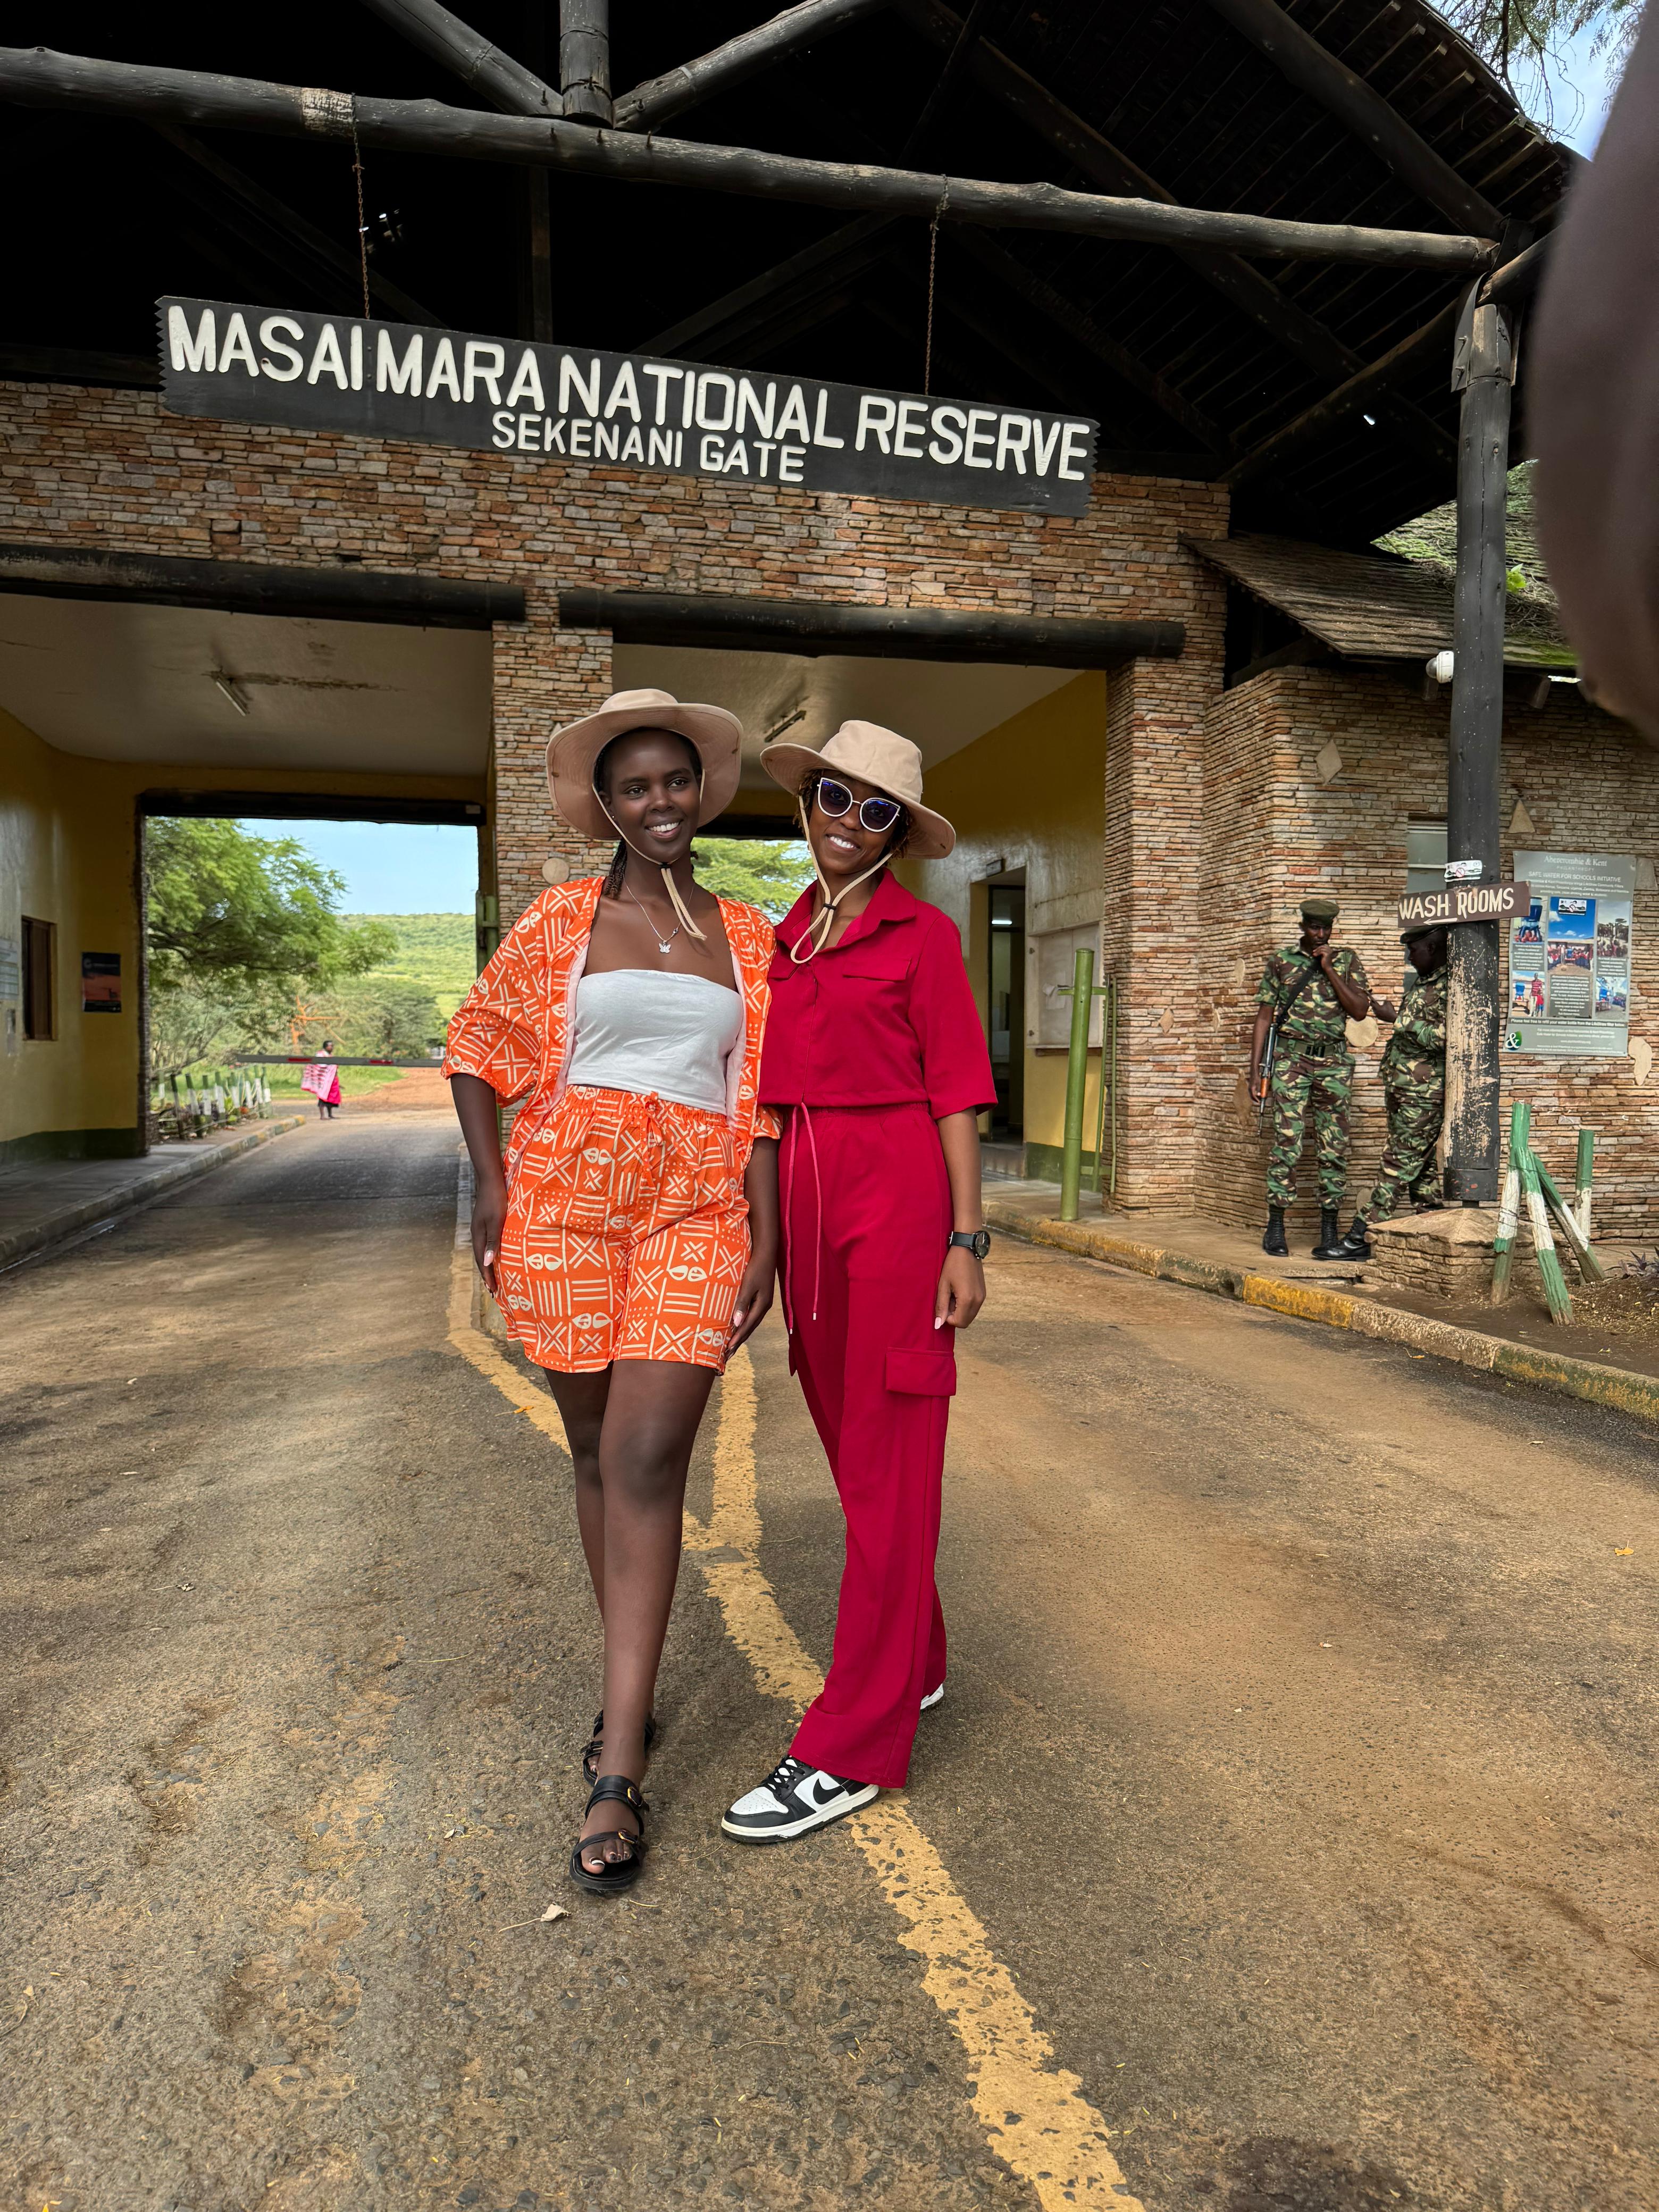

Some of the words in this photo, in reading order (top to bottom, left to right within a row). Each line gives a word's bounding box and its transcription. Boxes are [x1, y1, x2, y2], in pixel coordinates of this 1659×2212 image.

[168, 305, 363, 391] MASAI
[376, 329, 546, 412] MARA
[558, 354, 844, 449] NATIONAL
[855, 395, 1091, 481] RESERVE
[492, 411, 683, 467] SEKENANI
[700, 434, 807, 482] GATE
[1544, 855, 1584, 865] Abercrombie
[1593, 858, 1607, 867] Kent
[1398, 893, 1449, 920] WASH
[1456, 887, 1514, 919] ROOMS
